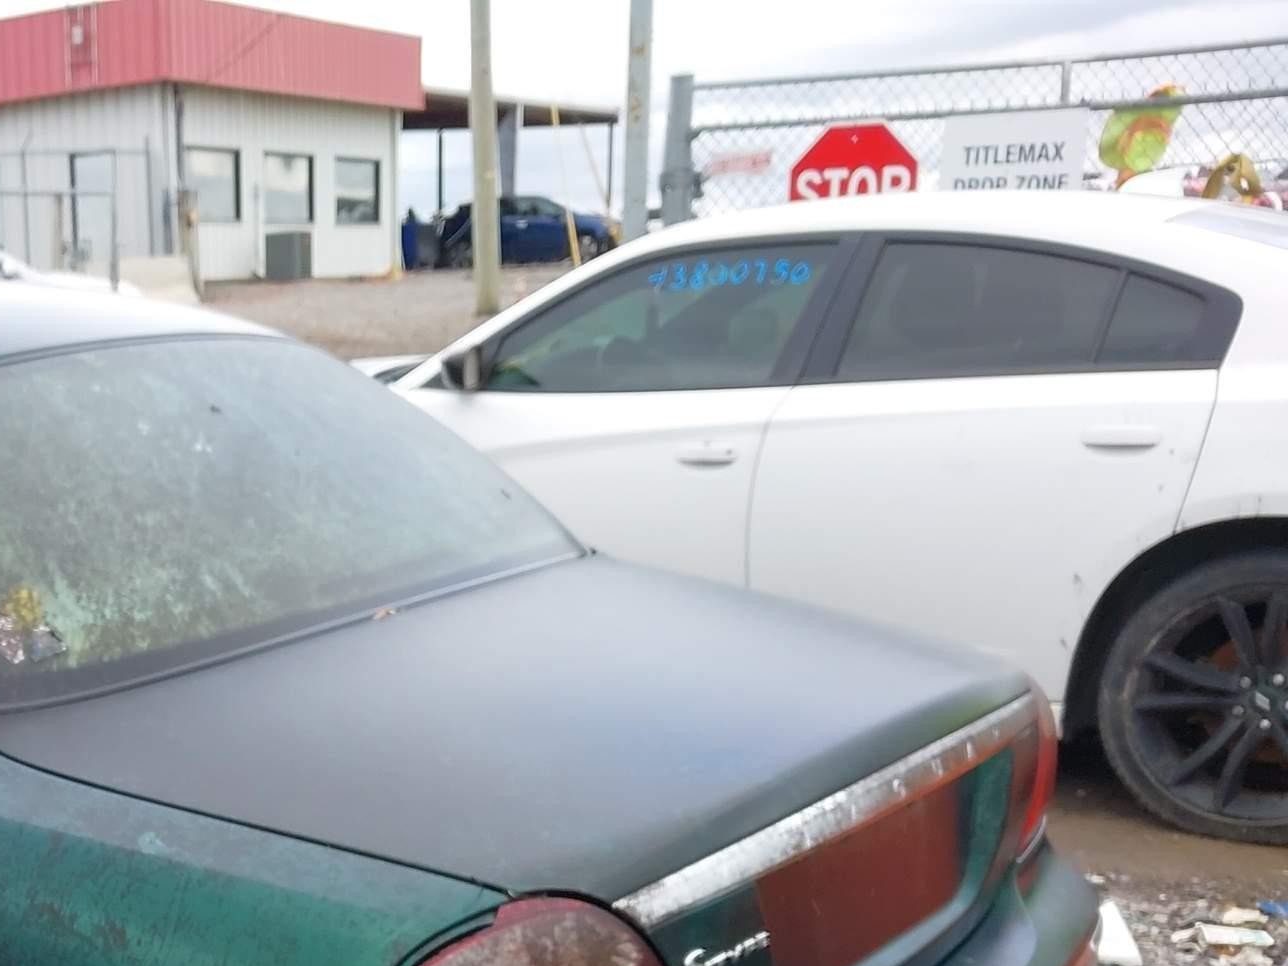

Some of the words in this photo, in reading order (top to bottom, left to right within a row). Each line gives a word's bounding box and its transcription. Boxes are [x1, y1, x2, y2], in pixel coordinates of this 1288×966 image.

[963, 142, 1065, 167] TITLEMAX
[796, 164, 911, 200] STOP
[1016, 173, 1068, 190] ZONE
